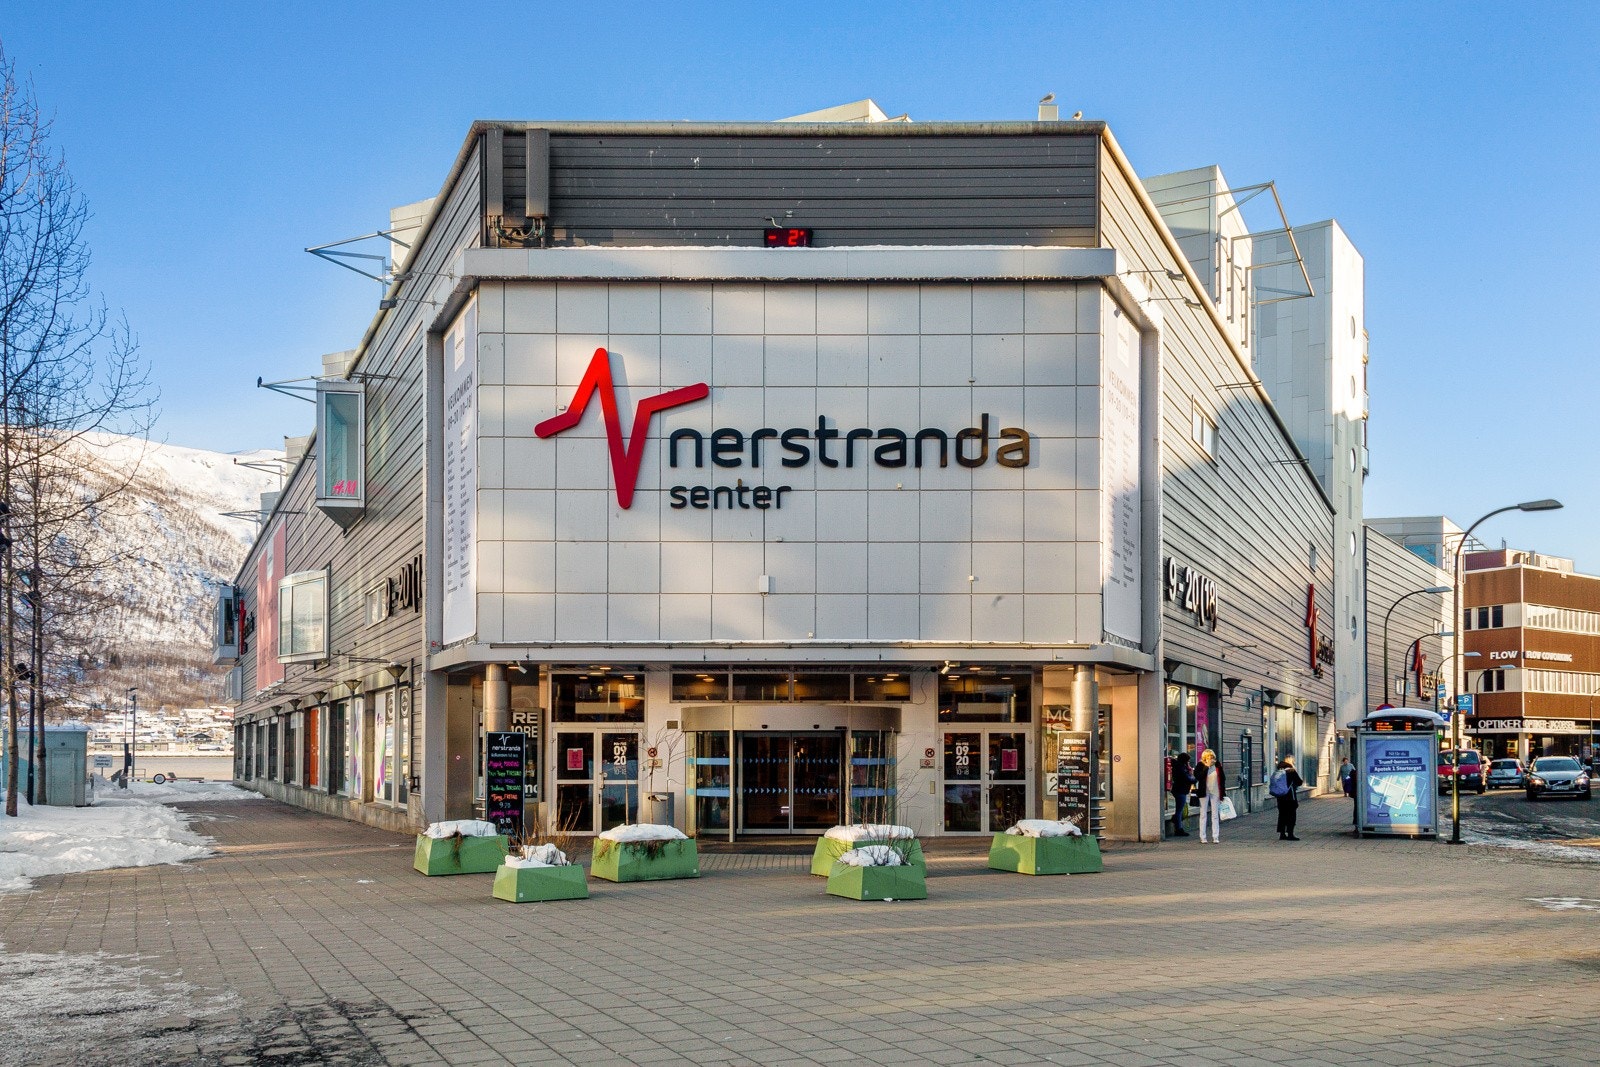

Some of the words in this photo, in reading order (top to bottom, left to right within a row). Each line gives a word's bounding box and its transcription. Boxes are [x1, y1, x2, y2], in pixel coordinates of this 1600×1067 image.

[669, 412, 1031, 468] nerstranda
[669, 478, 792, 510] senter
[1489, 650, 1518, 660] FLOW
[1478, 719, 1521, 729] OPTIKER
[613, 745, 627, 756] 09
[955, 745, 970, 756] 09
[613, 755, 627, 766] 20
[955, 755, 970, 766] 20
